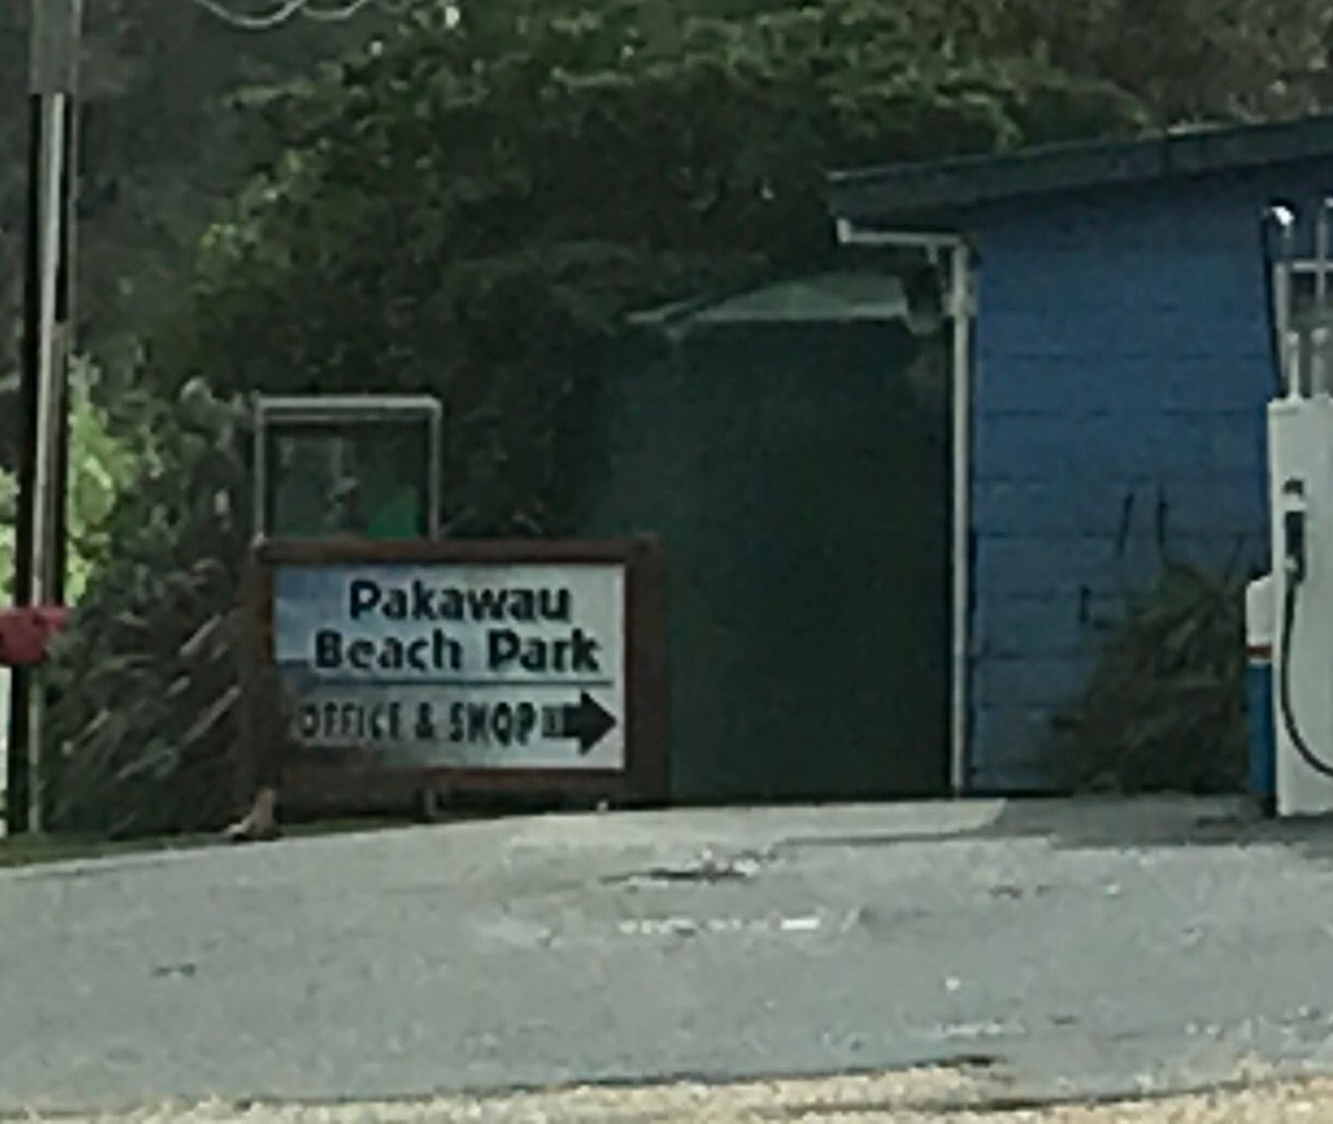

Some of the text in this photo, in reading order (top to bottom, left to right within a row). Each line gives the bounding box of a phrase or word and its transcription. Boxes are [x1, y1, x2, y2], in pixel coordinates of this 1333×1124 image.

[348, 579, 572, 622] Pakawau
[314, 628, 601, 673] Beach Park
[301, 701, 538, 746] OFFICE & SHOP
